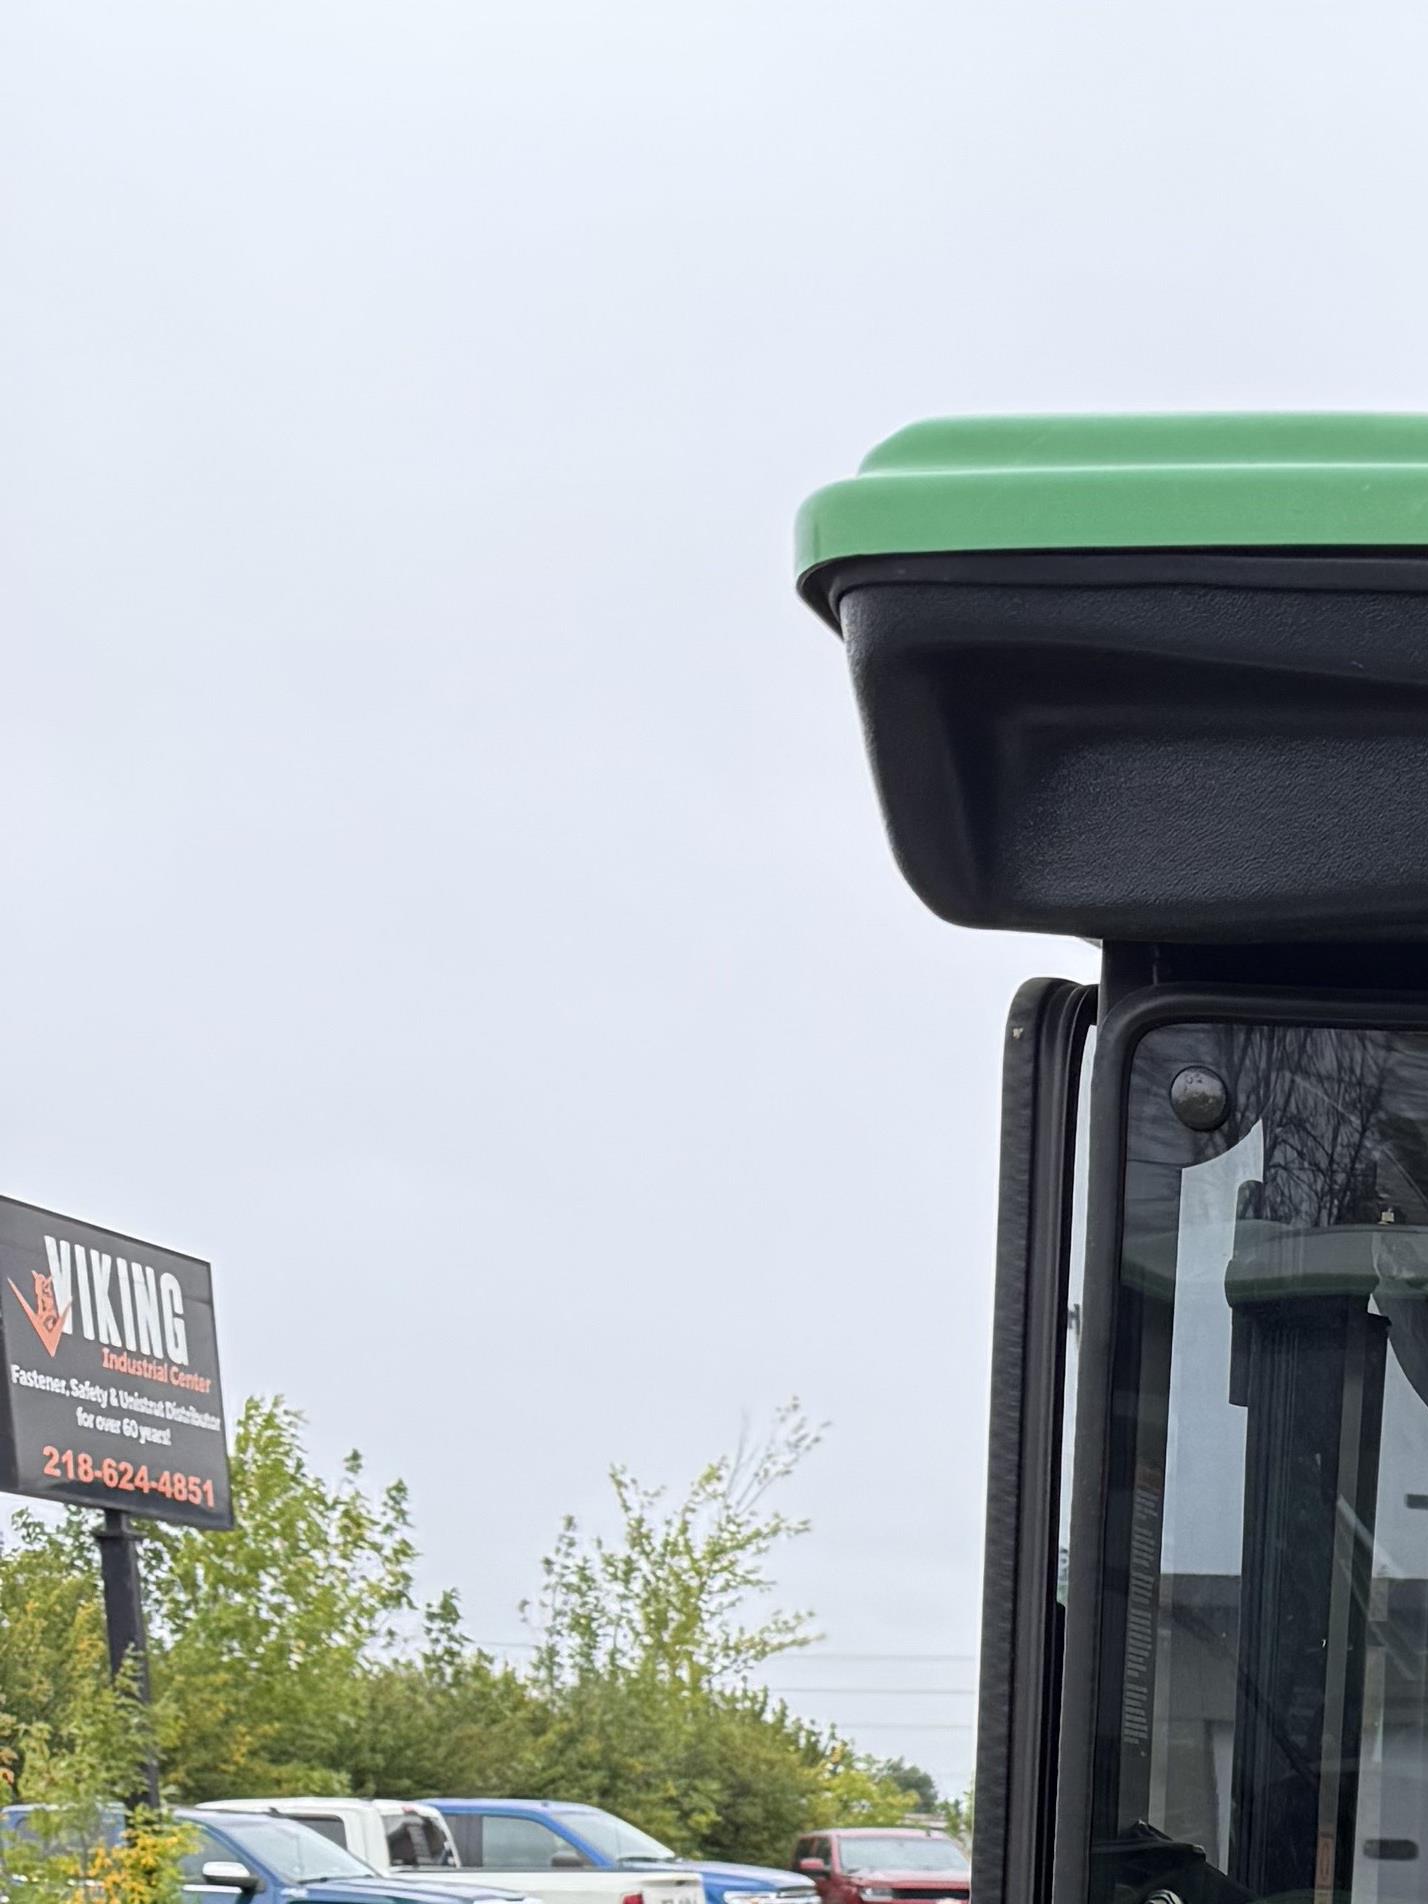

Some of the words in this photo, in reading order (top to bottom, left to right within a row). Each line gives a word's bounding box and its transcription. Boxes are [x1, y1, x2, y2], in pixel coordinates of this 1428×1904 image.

[44, 1235, 189, 1366] VIKING
[10, 1364, 70, 1397] Fastener,
[70, 1378, 108, 1408] Safety
[109, 1388, 120, 1407] &
[102, 1348, 168, 1383] Industrial
[170, 1366, 211, 1393] Center
[76, 1406, 93, 1428] for
[96, 1417, 121, 1434] over
[122, 1418, 138, 1438] 60
[43, 1445, 214, 1507] 218-624-4851
